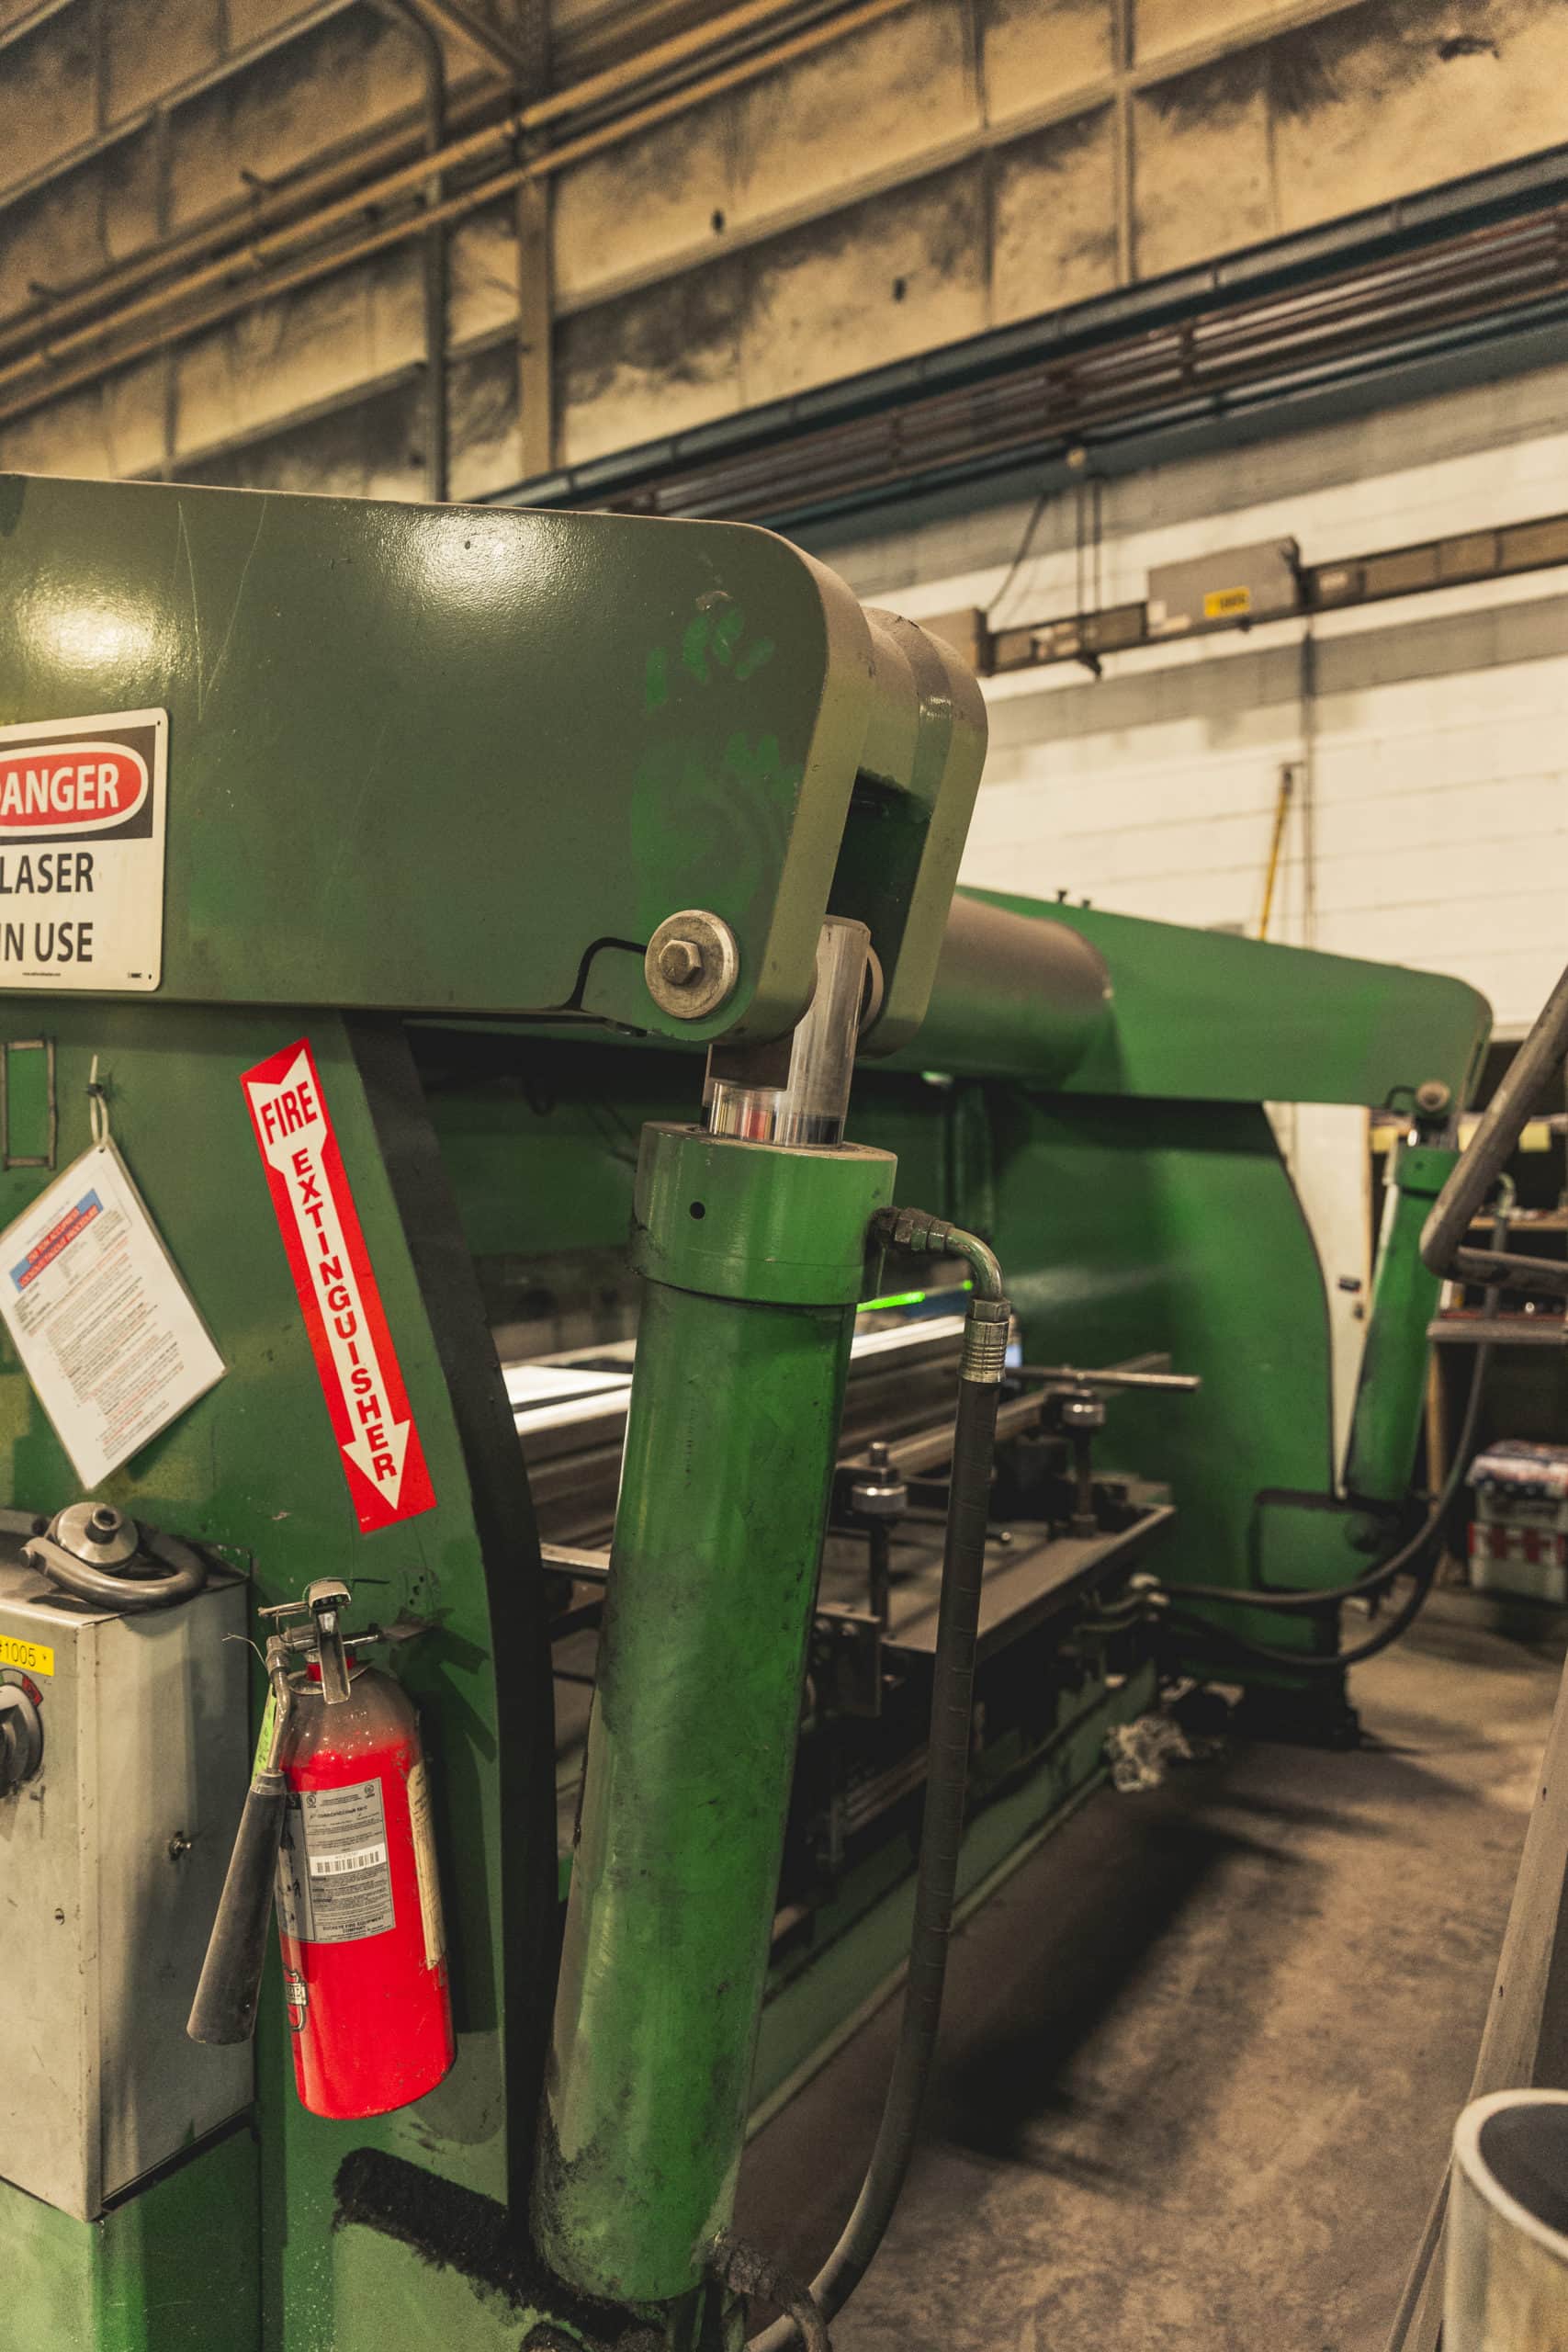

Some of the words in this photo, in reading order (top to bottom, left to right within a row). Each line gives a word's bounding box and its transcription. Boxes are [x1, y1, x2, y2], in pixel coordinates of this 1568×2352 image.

[0, 763, 119, 816] ANGER
[0, 853, 94, 894] LASER
[0, 922, 24, 962] N
[35, 922, 93, 962] USE
[260, 1080, 318, 1145] FIRE
[291, 1148, 397, 1482] EXTINGUISHER
[0, 1641, 36, 1667] 1005
